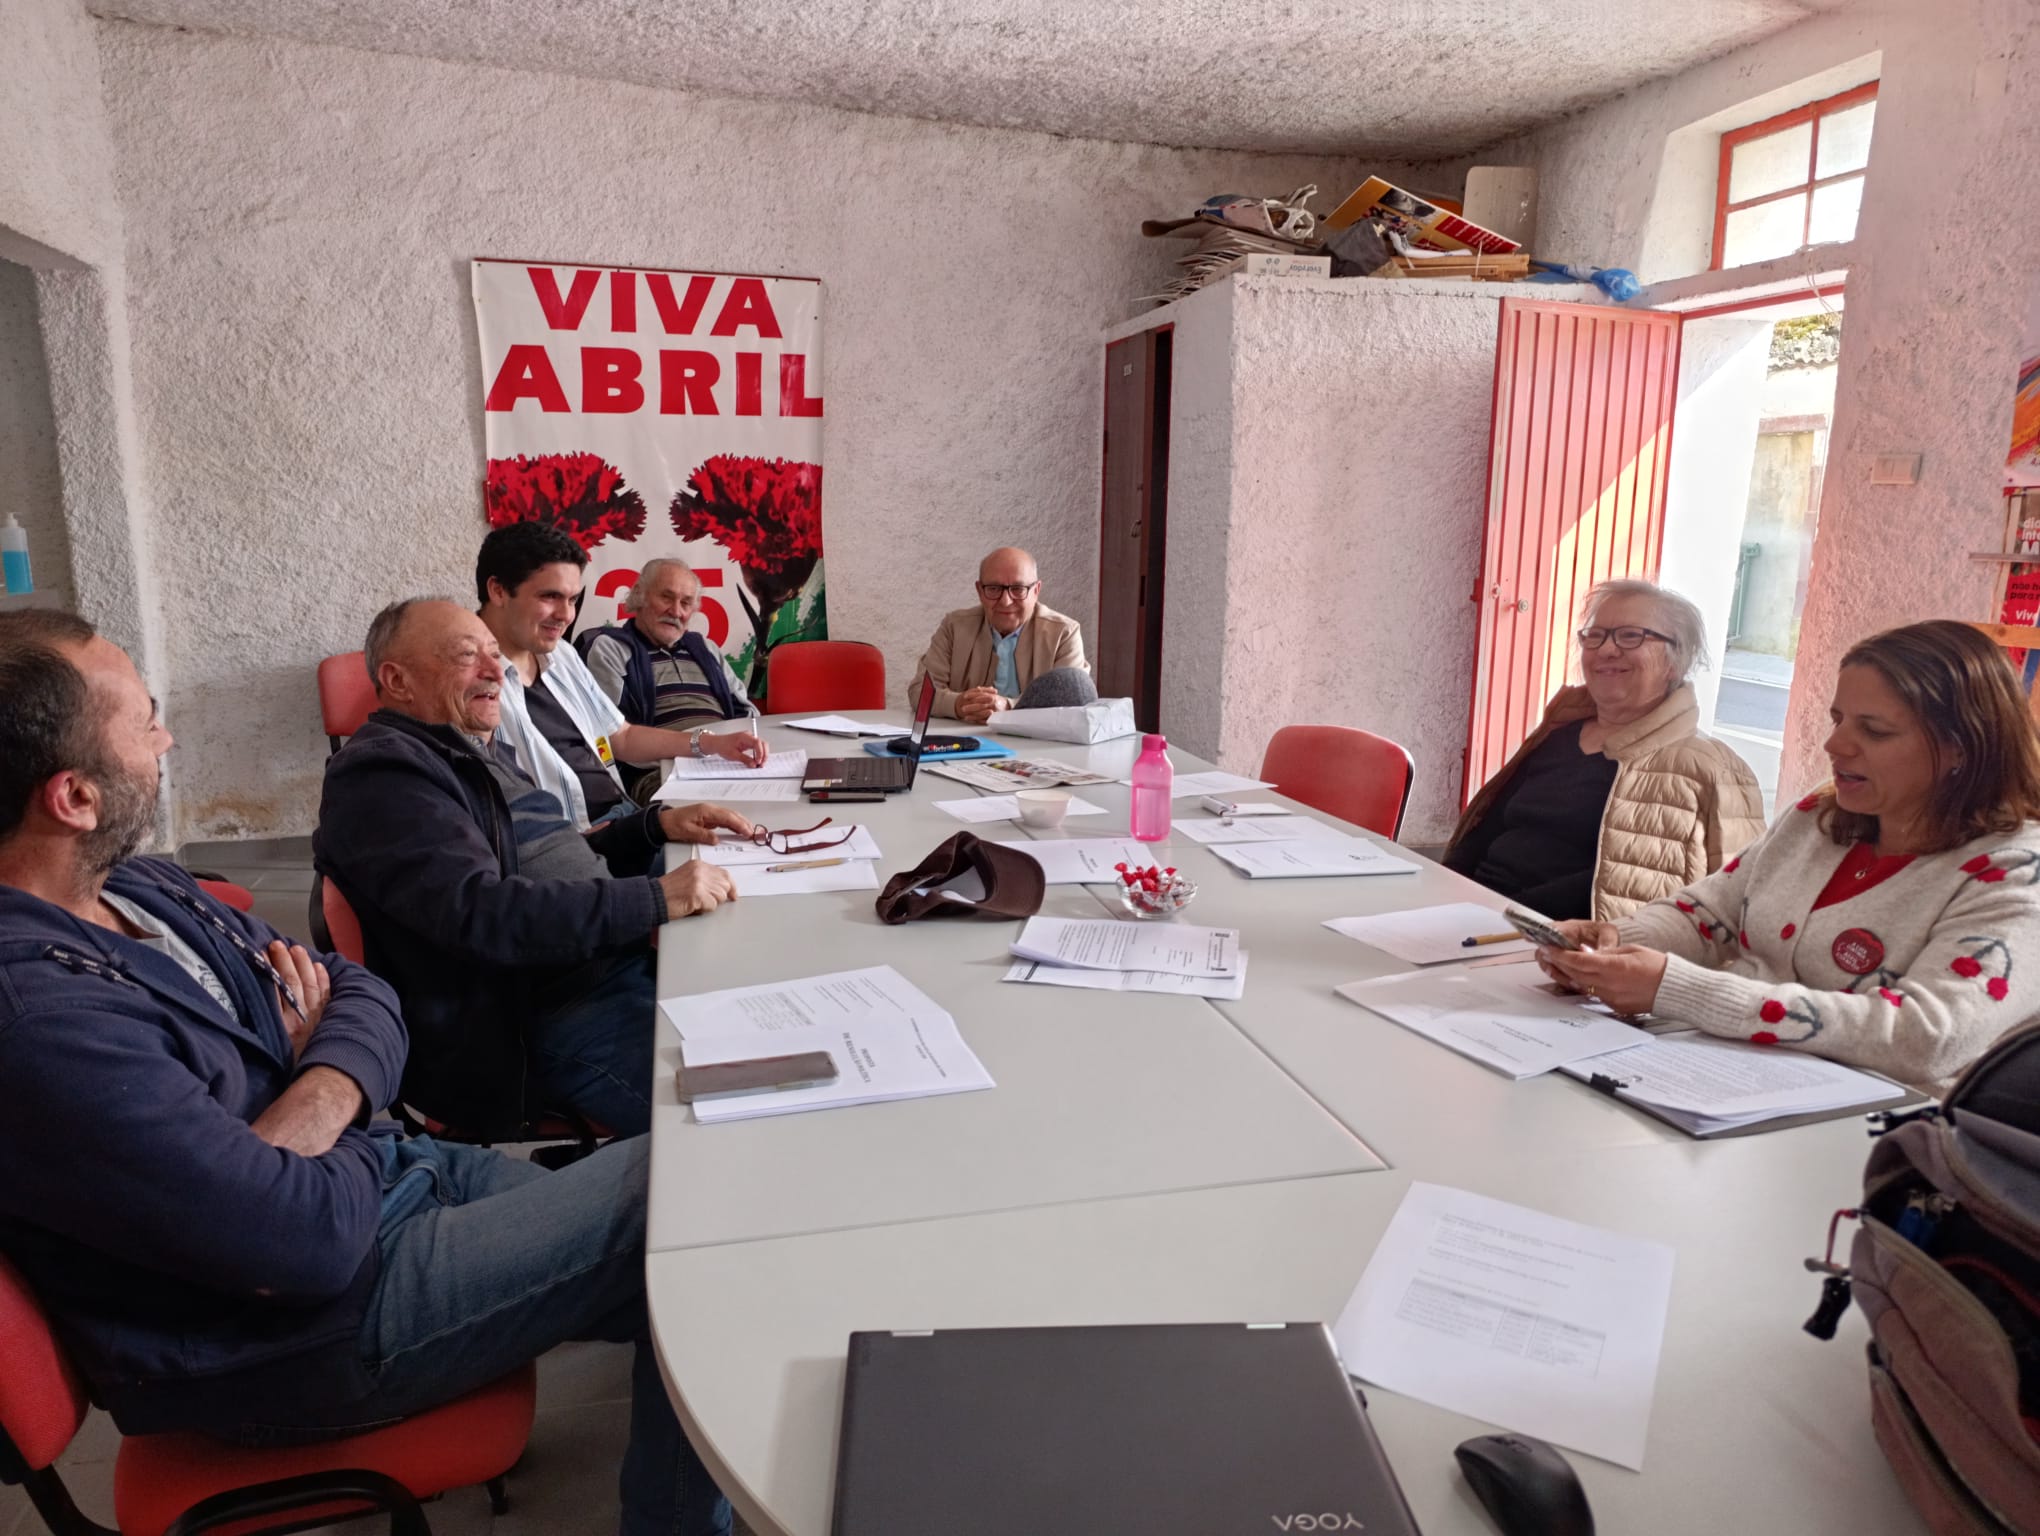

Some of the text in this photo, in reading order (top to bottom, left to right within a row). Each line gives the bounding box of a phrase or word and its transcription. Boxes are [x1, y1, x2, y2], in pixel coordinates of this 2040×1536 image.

[527, 267, 782, 338] VIVA
[485, 344, 824, 417] ABRIL
[1271, 1512, 1364, 1531] YOGA
